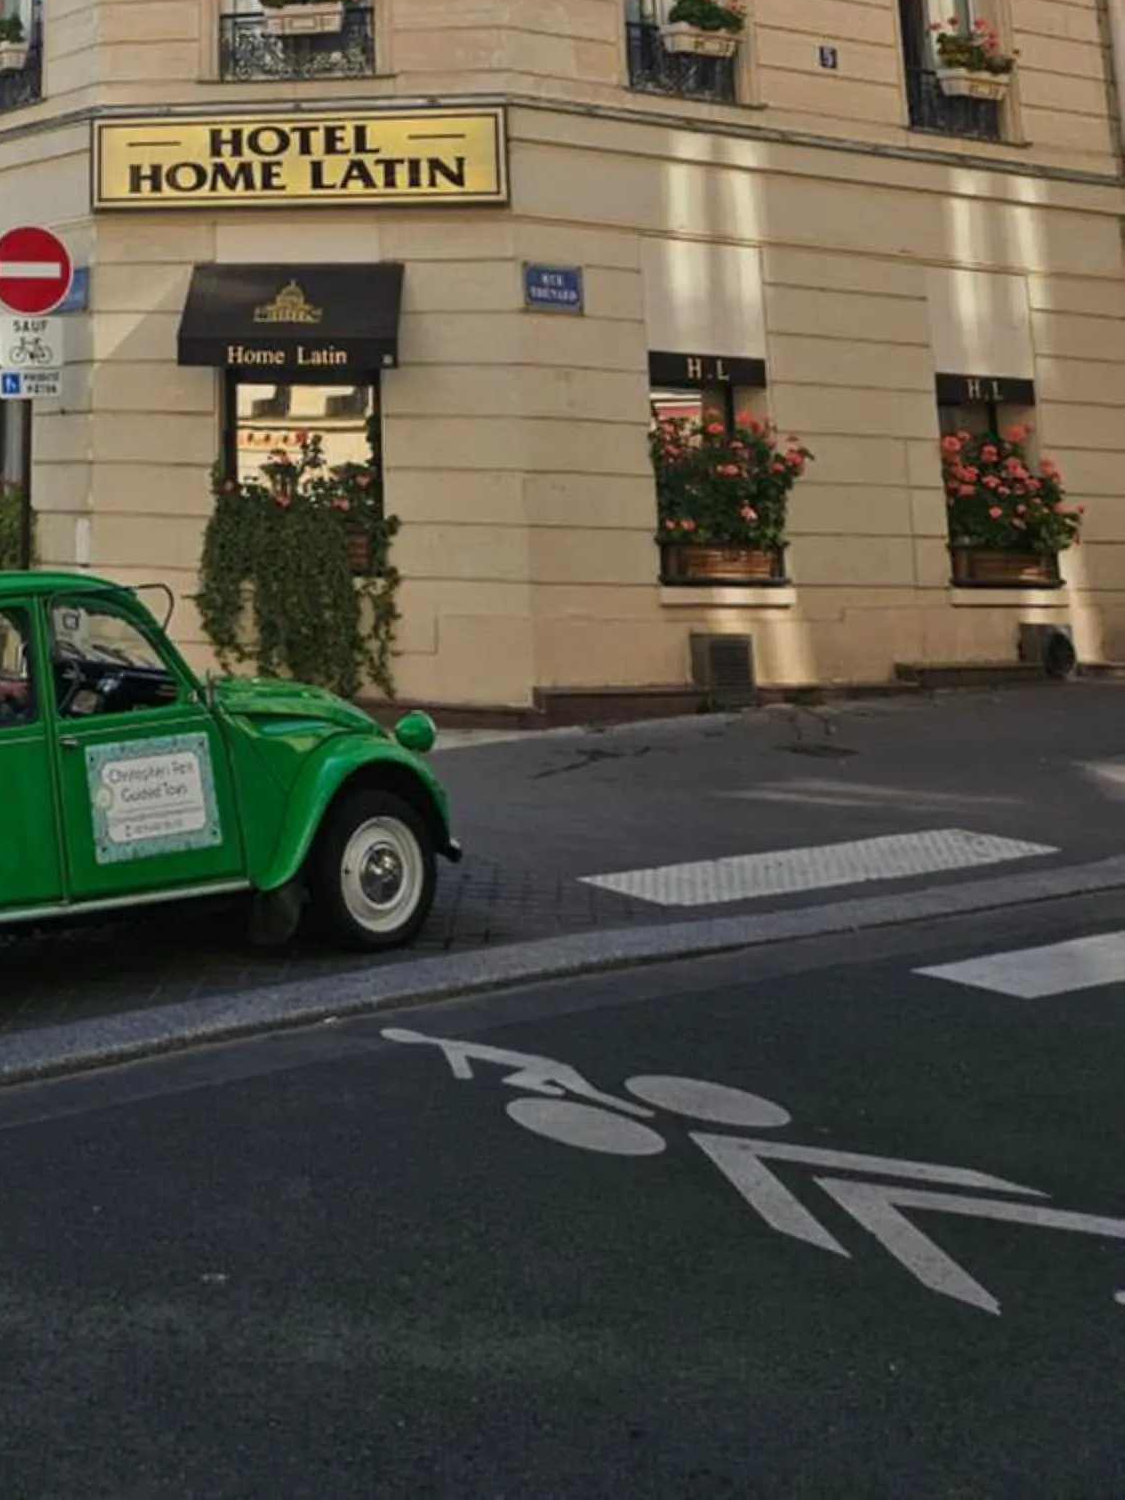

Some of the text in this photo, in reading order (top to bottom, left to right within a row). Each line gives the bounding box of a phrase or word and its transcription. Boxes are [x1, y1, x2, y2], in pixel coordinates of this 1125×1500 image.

[209, 125, 380, 157] HOTEL
[128, 157, 466, 193] HOME LATIN
[13, 319, 48, 332] SAUF
[227, 344, 348, 364] Home Latin
